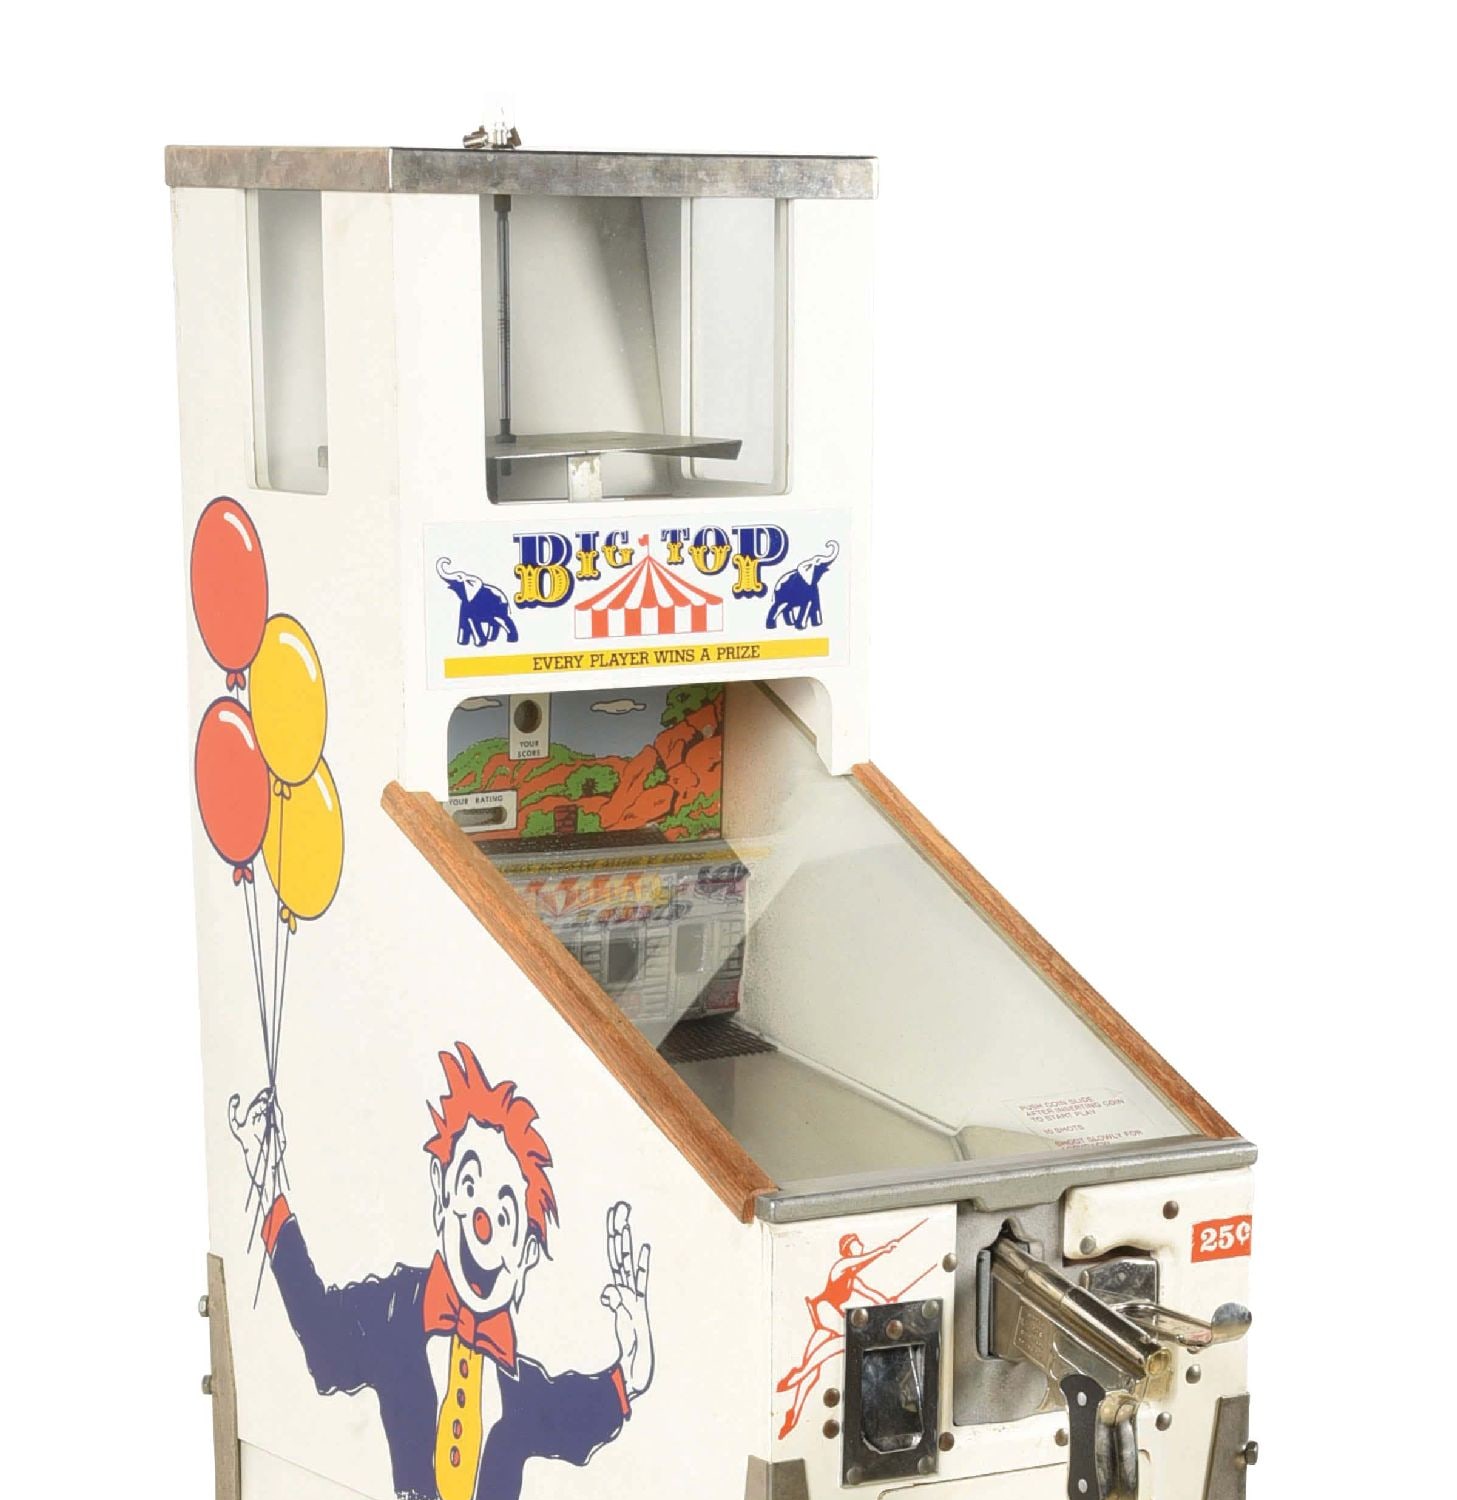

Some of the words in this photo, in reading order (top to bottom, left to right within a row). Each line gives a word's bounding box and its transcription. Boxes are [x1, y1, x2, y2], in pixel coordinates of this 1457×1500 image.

[512, 529, 633, 609] BIG
[660, 524, 789, 600] TOP
[532, 655, 584, 671] EVERY
[590, 652, 650, 668] PLAYER
[653, 648, 695, 664] WINS
[700, 648, 711, 662] A
[717, 645, 761, 660] PRIZE
[519, 740, 539, 748] YOUR
[517, 749, 540, 758] SCORE
[449, 798, 469, 806] YOUR
[475, 795, 503, 804] RATING
[1199, 1221, 1251, 1253] 25¢
